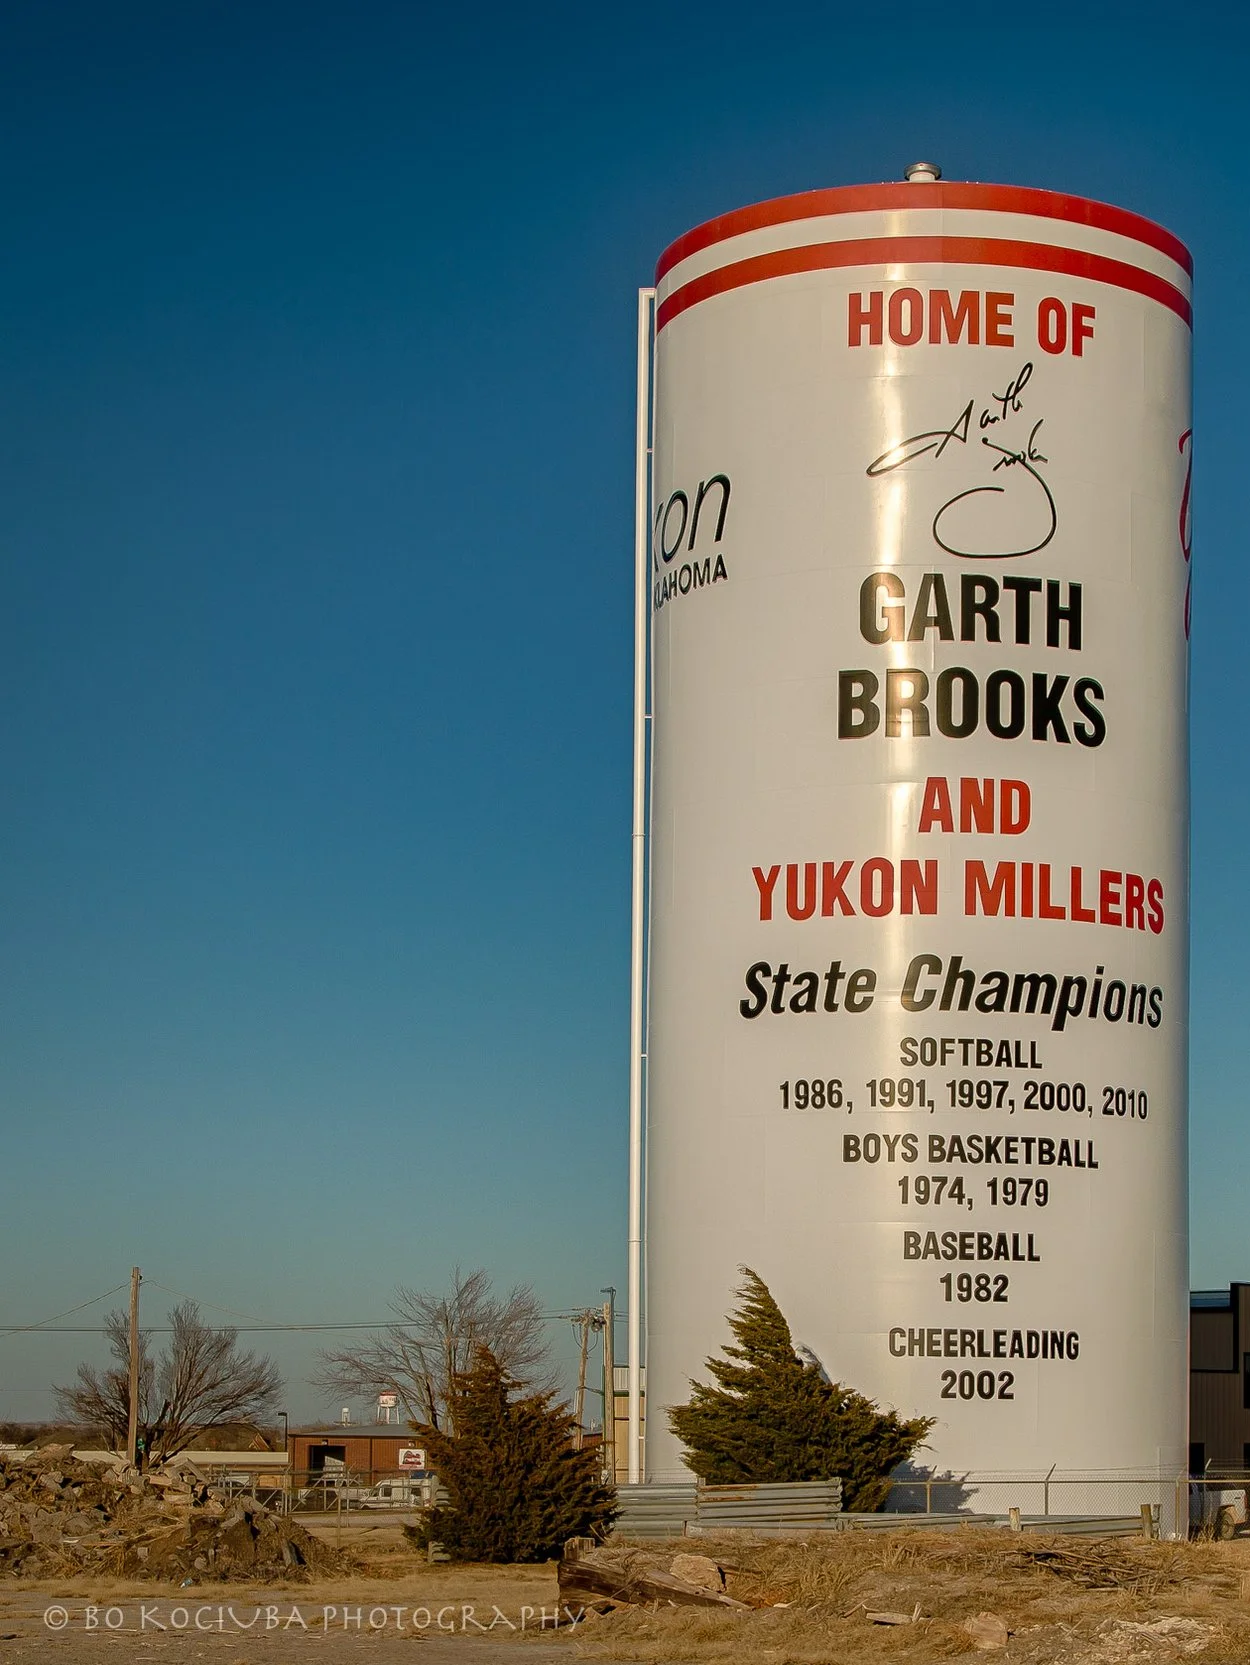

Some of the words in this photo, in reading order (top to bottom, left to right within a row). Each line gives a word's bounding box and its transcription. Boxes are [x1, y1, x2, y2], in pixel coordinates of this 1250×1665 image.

[849, 287, 1014, 347] HOME
[1038, 298, 1095, 357] OF
[860, 572, 1082, 651] GARTH
[838, 667, 1106, 747] BROOKS
[918, 776, 1030, 834] AND
[751, 857, 937, 920] YUKON
[964, 861, 1163, 933] MILLERS
[740, 961, 876, 1019] State
[902, 954, 1162, 1031] Champions
[900, 1037, 1042, 1069] SOFTBALL
[780, 1079, 852, 1114] 1986,
[866, 1078, 934, 1114] 1991,
[946, 1079, 1014, 1114] 1997,
[1024, 1081, 1092, 1118] 2000,
[1102, 1086, 1149, 1120] 2010
[843, 1133, 918, 1163] BOYS
[929, 1135, 1098, 1169] BASKETBALL
[899, 1176, 973, 1211] 1974,
[987, 1177, 1048, 1207] 1979
[904, 1231, 1040, 1262] BASEBALL
[940, 1273, 1008, 1302] 1982
[889, 1328, 1079, 1360] CHEERLEADING
[941, 1370, 1014, 1400] 2002
